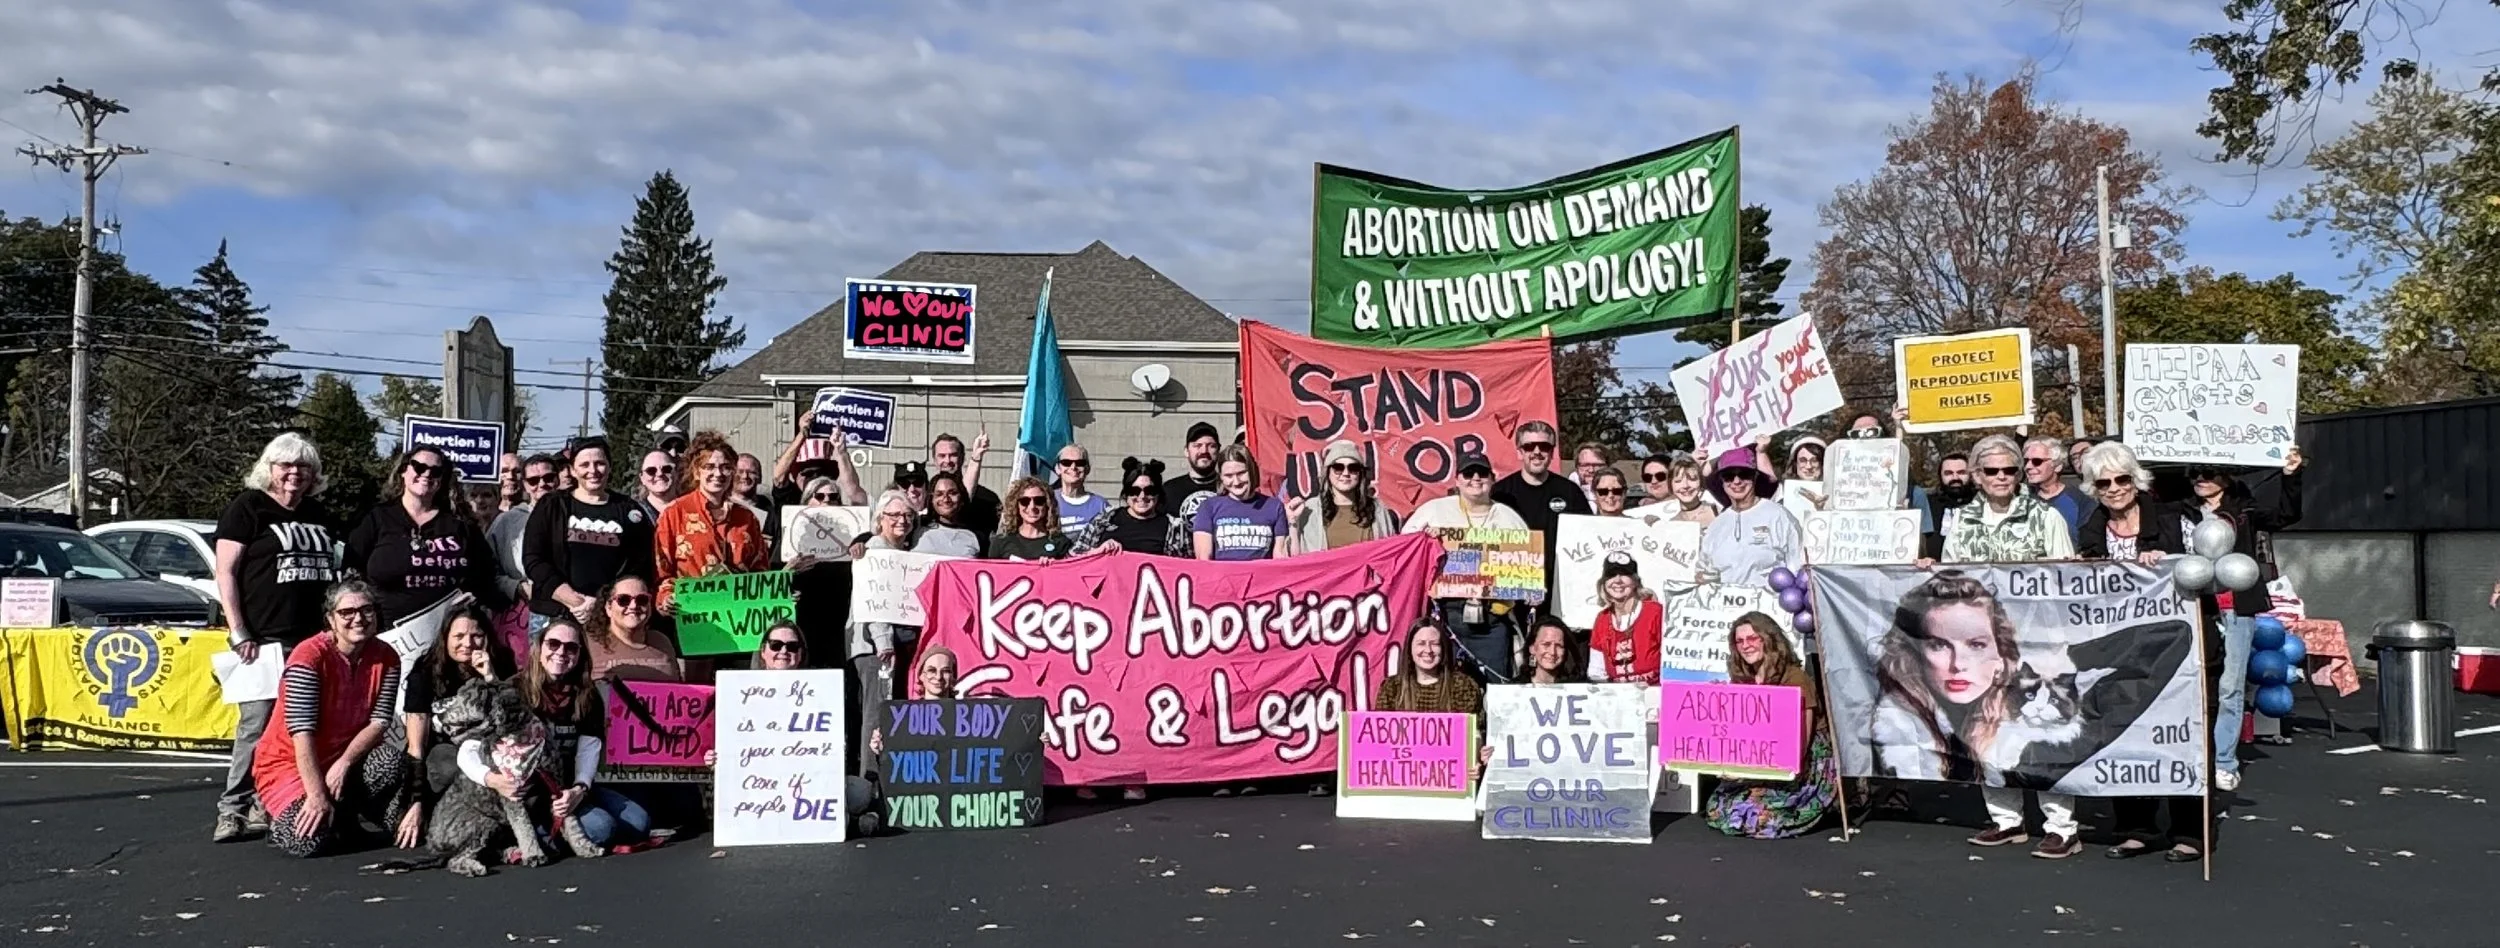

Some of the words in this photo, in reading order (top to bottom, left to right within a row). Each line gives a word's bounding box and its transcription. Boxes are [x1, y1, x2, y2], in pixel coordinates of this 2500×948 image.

[1342, 203, 1499, 258] ABORTION
[1507, 199, 1558, 249] ON
[1563, 167, 1716, 241] DEMAND
[1354, 279, 1379, 331] &
[1383, 268, 1534, 329] WITHOUT
[1543, 236, 1708, 312] APOLOGY!
[862, 295, 900, 317] We
[863, 323, 965, 346] CLINIC
[1931, 349, 1995, 368] PROTECT
[2130, 346, 2262, 383] HIPAA
[1695, 350, 1772, 407] YOUR
[1909, 369, 2021, 391] REPRODUCTIVE
[817, 403, 871, 416] Abortion
[874, 407, 885, 417] is
[1291, 362, 1484, 441] STAND
[1938, 393, 1993, 409] RIGHTS
[2134, 382, 2255, 413] exists
[816, 414, 884, 431] Healthcare
[1698, 387, 1785, 445] HEALTH
[2135, 414, 2180, 444] for
[415, 432, 475, 448] Abortion
[479, 436, 491, 448] is
[1440, 527, 1464, 542] PRO
[1466, 528, 1530, 545] ABORTION
[1563, 542, 1593, 561] WE
[1642, 536, 1659, 552] GO
[411, 554, 468, 569] before
[679, 582, 689, 594] I
[693, 580, 715, 593] AM
[717, 580, 729, 592] A
[734, 572, 795, 601] HUMAN
[2009, 570, 2052, 598] Cat
[2057, 568, 2143, 597] Ladies,
[1724, 595, 1747, 606] NO
[2068, 599, 2129, 626] Stand
[2132, 596, 2187, 619] Back
[682, 611, 710, 626] NOT
[711, 611, 722, 623] A
[975, 570, 1112, 675] Keep
[1126, 561, 1391, 661] Abortion
[71, 631, 102, 697] DAYTON
[137, 645, 175, 699] RIGHTS
[665, 691, 702, 719] Are
[740, 682, 777, 704] pro
[785, 680, 816, 706] life
[889, 703, 947, 737] YOUR
[955, 703, 1013, 739] BODY
[1147, 683, 1190, 749] &
[1529, 694, 1592, 727] WE
[1676, 690, 1772, 725] ABORTION
[77, 712, 164, 734] ALLIANCE
[737, 718, 755, 733] is
[765, 720, 782, 733] a
[787, 711, 832, 733] LIE
[1357, 716, 1452, 748] ABORTION
[1711, 723, 1729, 738] IS
[2152, 717, 2191, 745] and
[64, 727, 75, 739] &
[76, 730, 131, 749] Respect
[133, 737, 153, 748] for
[157, 739, 178, 749] All
[628, 724, 702, 760] LOVED
[1506, 731, 1636, 768] LOVE
[1673, 734, 1779, 768] HEALTHCARE
[740, 746, 776, 767] you
[781, 742, 833, 757] don't
[888, 751, 942, 784] YOUR
[951, 747, 1004, 784] LIFE
[1391, 746, 1413, 760] IS
[788, 772, 812, 798] if
[1357, 759, 1458, 789] HEALTHCARE
[2094, 759, 2161, 785] Stand
[2170, 760, 2197, 788] By
[1526, 776, 1608, 802] OUR
[734, 796, 787, 819] people
[792, 798, 838, 822] DIE
[886, 794, 944, 828] YOUR
[950, 790, 1025, 829] CHOICE
[1493, 804, 1632, 831] CLINIC
